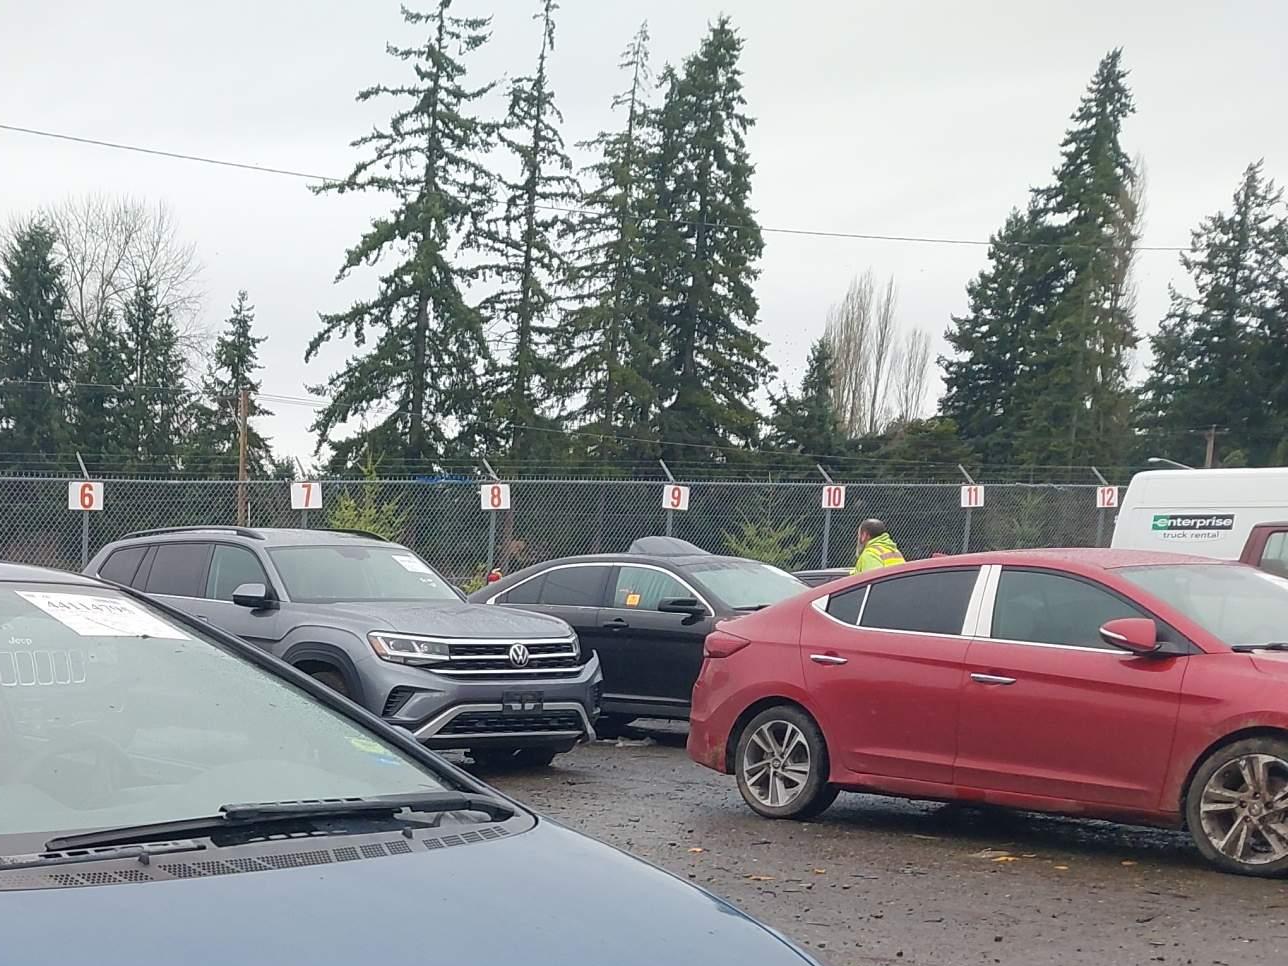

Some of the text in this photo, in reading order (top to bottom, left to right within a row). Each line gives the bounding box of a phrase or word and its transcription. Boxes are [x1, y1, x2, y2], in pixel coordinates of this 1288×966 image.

[80, 483, 94, 509] 6
[301, 483, 312, 508] 7
[490, 485, 502, 508] 8
[670, 486, 682, 508] 9
[826, 486, 842, 507] 10
[967, 486, 978, 506] 11
[1100, 487, 1114, 507] 12
[1154, 515, 1233, 529] enterprise
[1191, 530, 1220, 539] rental
